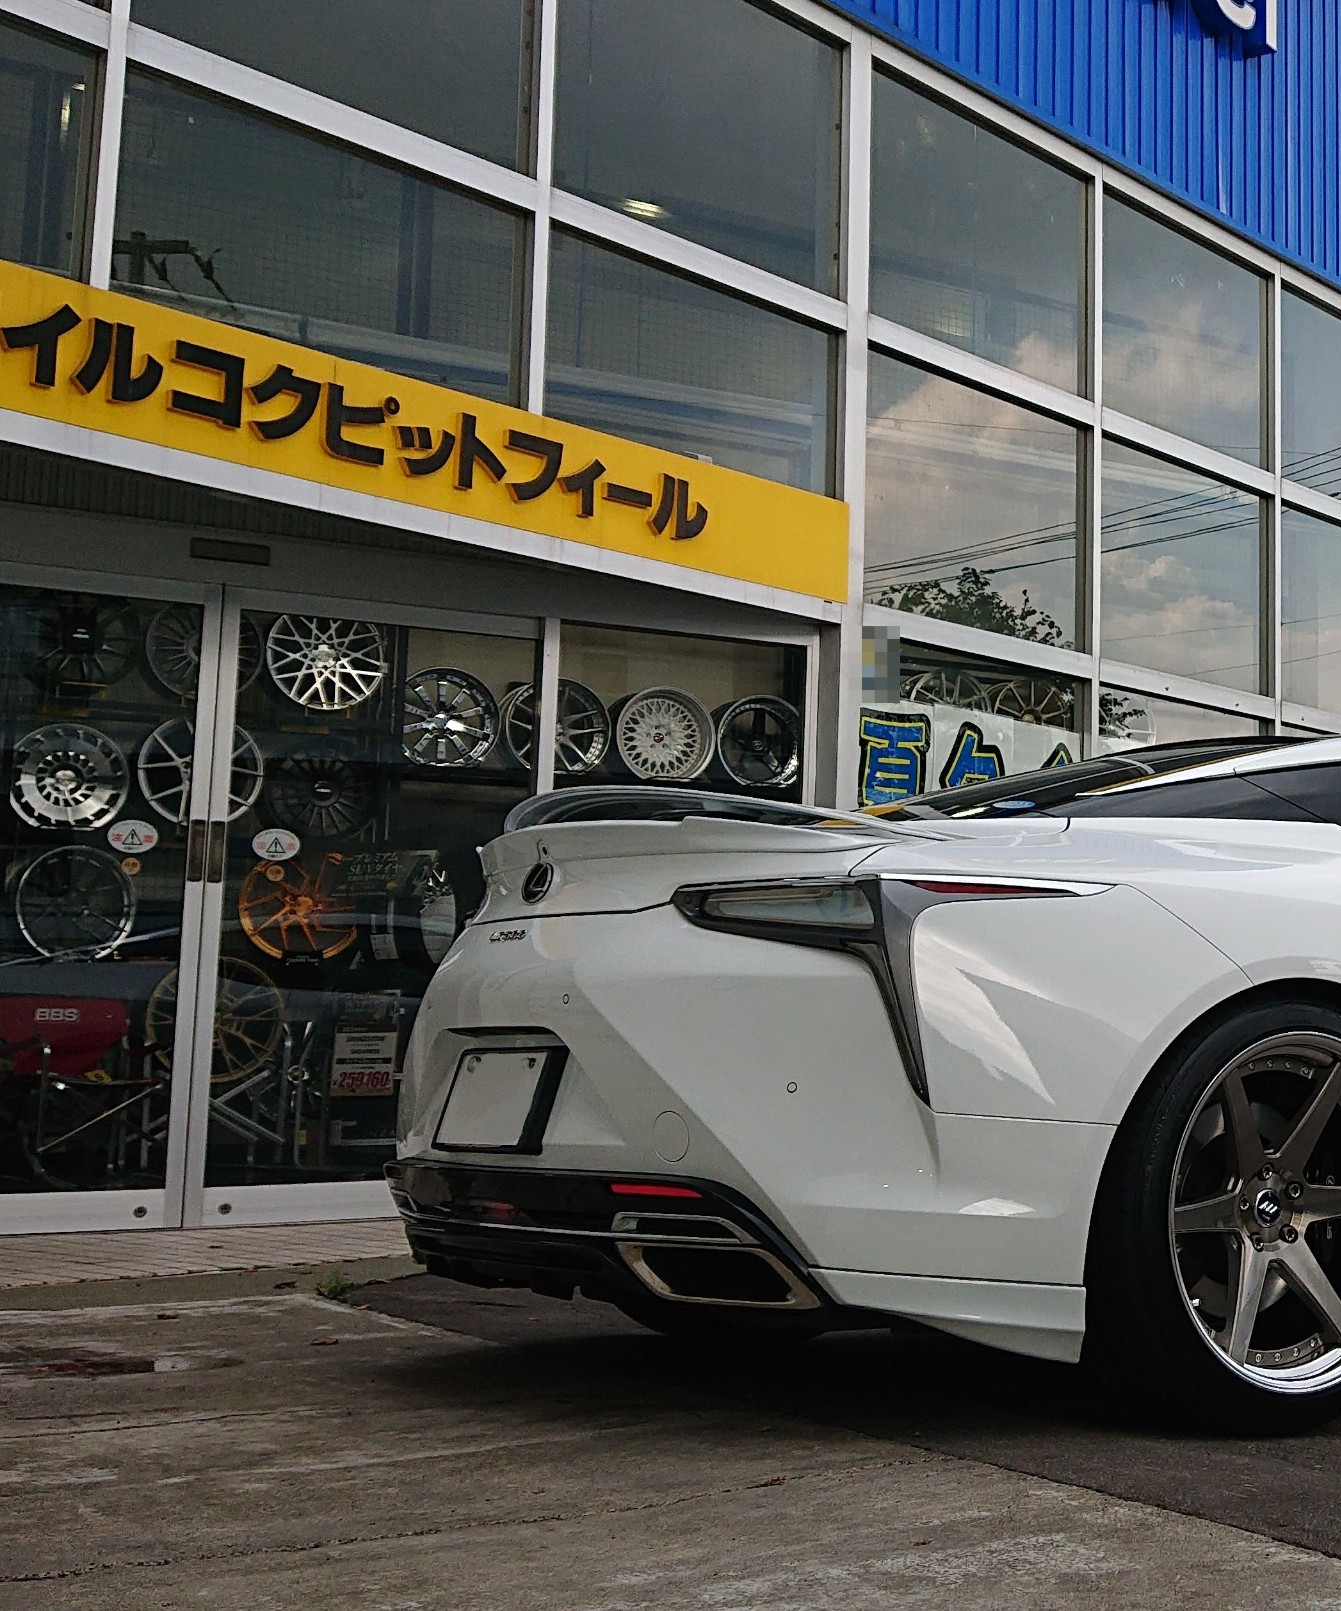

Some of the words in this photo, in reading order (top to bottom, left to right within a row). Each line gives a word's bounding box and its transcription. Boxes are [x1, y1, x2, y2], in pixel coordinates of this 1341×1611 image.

[1, 304, 709, 540] イルコクピットフィール
[35, 1008, 80, 1021] BBS
